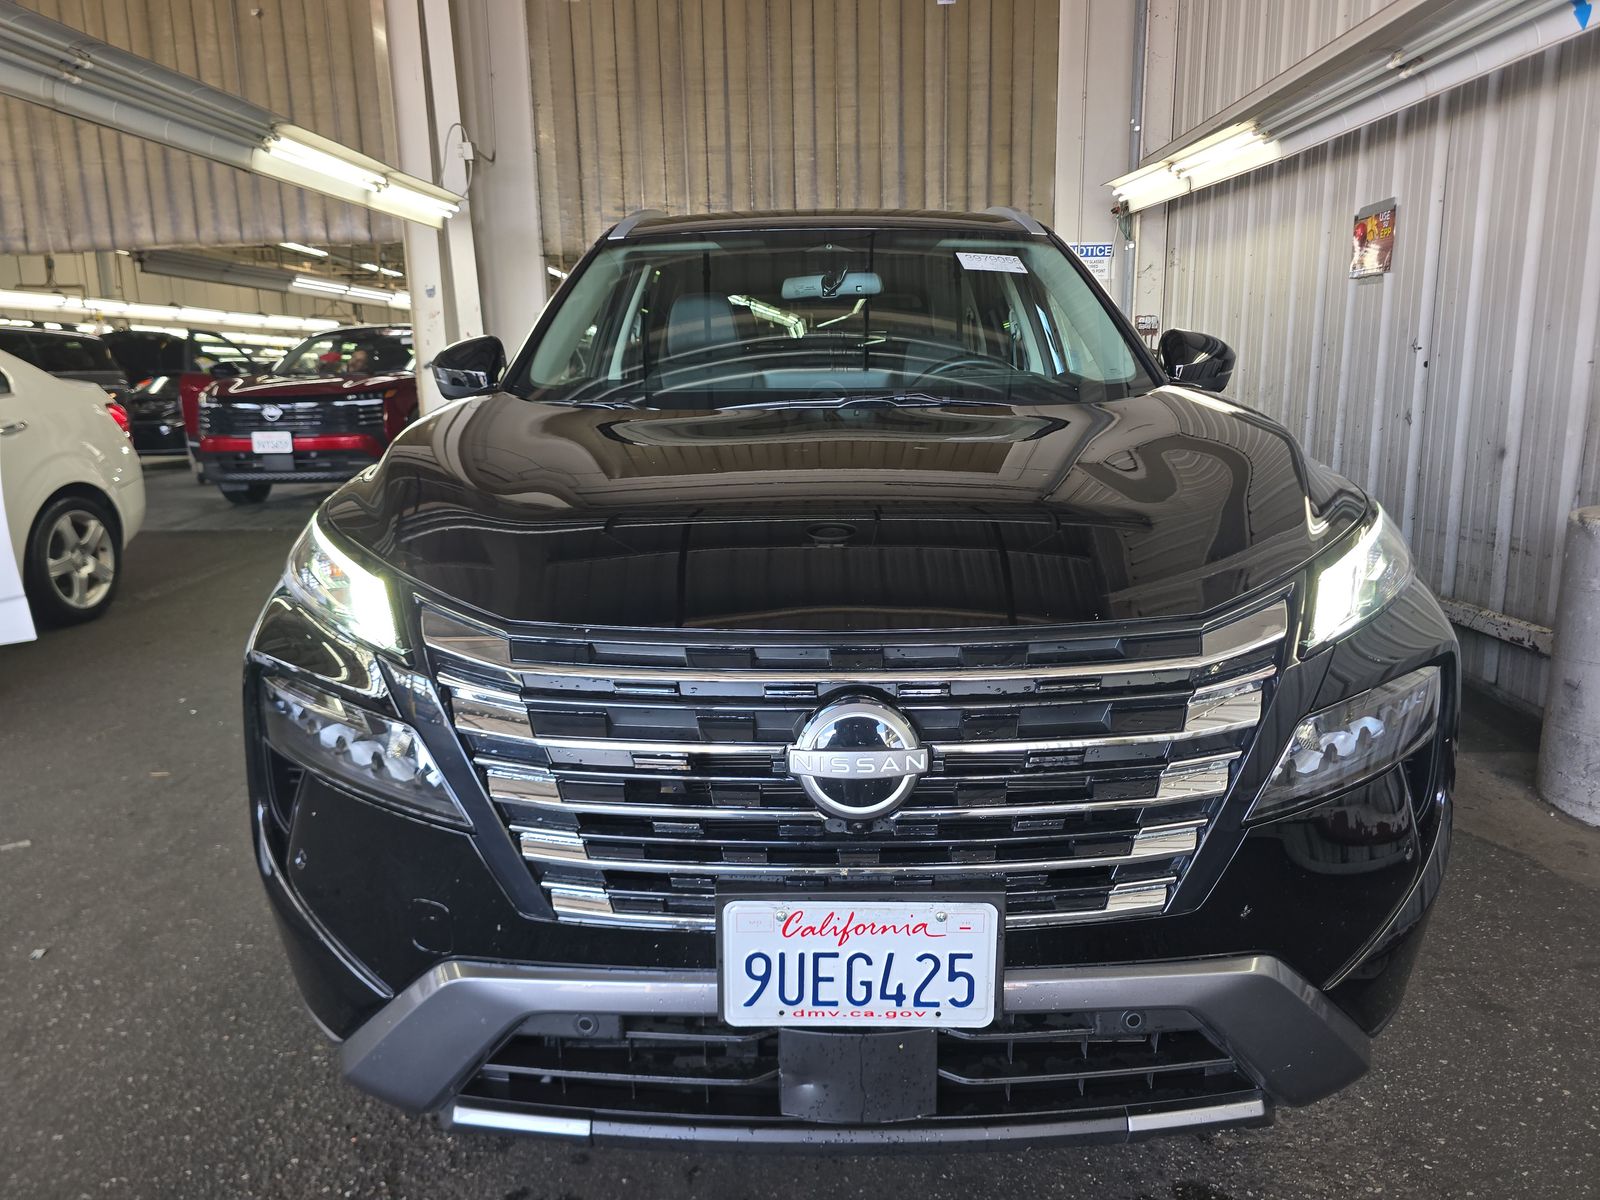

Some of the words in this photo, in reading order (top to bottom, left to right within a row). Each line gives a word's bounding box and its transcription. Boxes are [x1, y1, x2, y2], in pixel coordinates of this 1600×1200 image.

[793, 754, 925, 773] NISSAN
[781, 910, 946, 947] California
[743, 952, 976, 1008] 9UEG425
[792, 1009, 927, 1019] dmv.ca.gov
